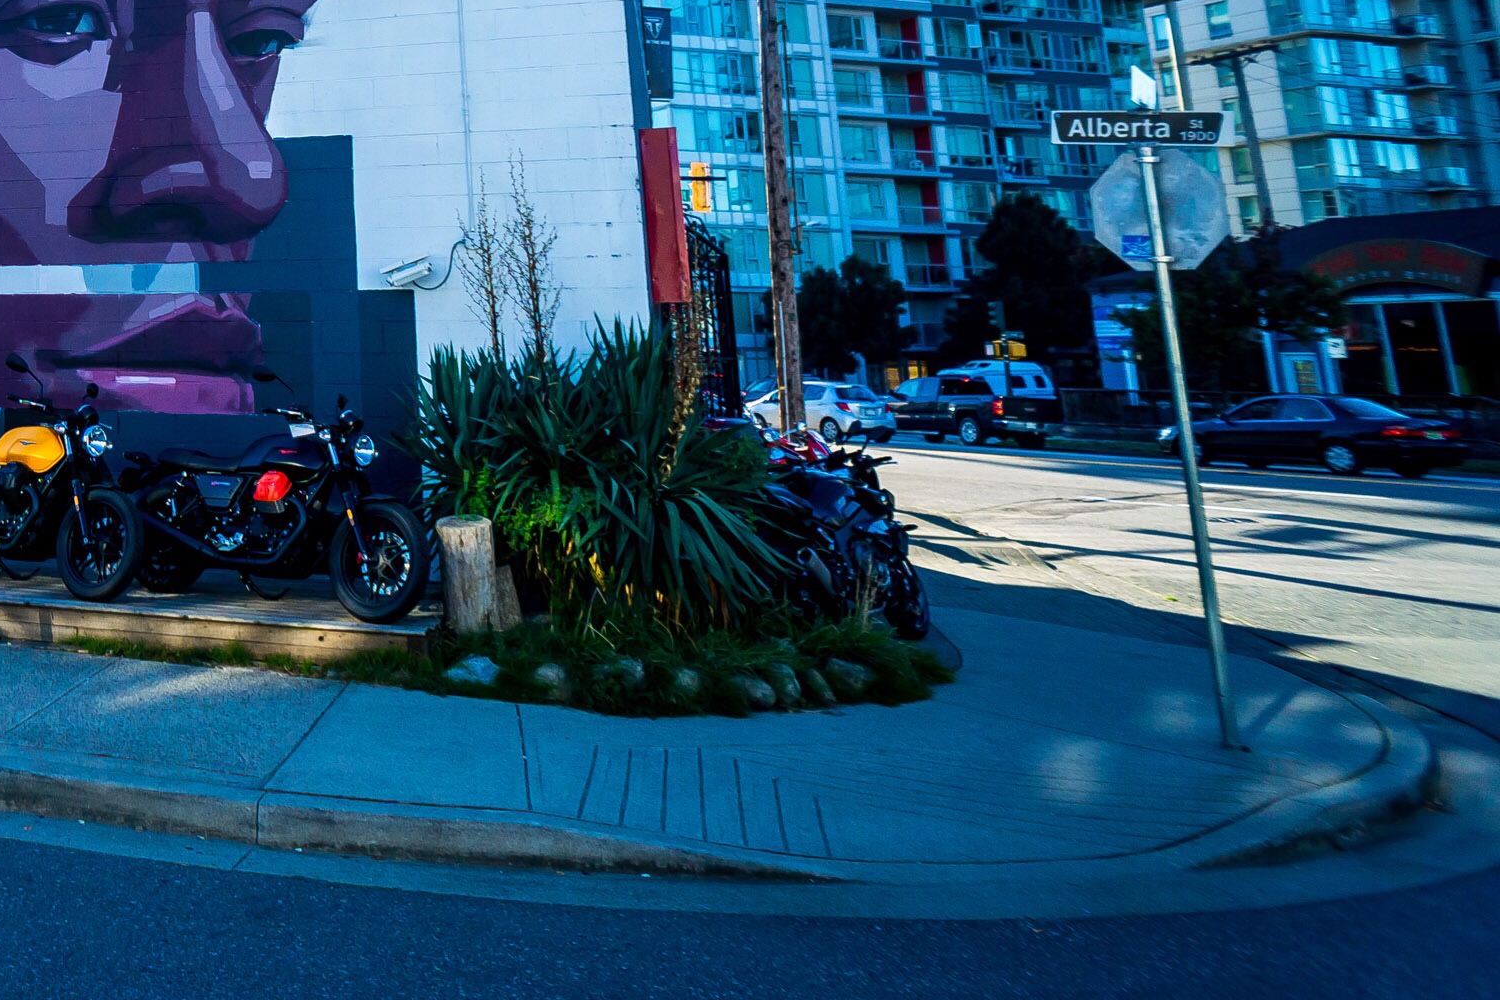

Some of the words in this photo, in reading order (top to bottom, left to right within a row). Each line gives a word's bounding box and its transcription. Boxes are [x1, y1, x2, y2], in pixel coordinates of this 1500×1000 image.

[1068, 117, 1171, 139] Alberta
[1189, 119, 1203, 129] St
[1180, 131, 1216, 141] 1900
